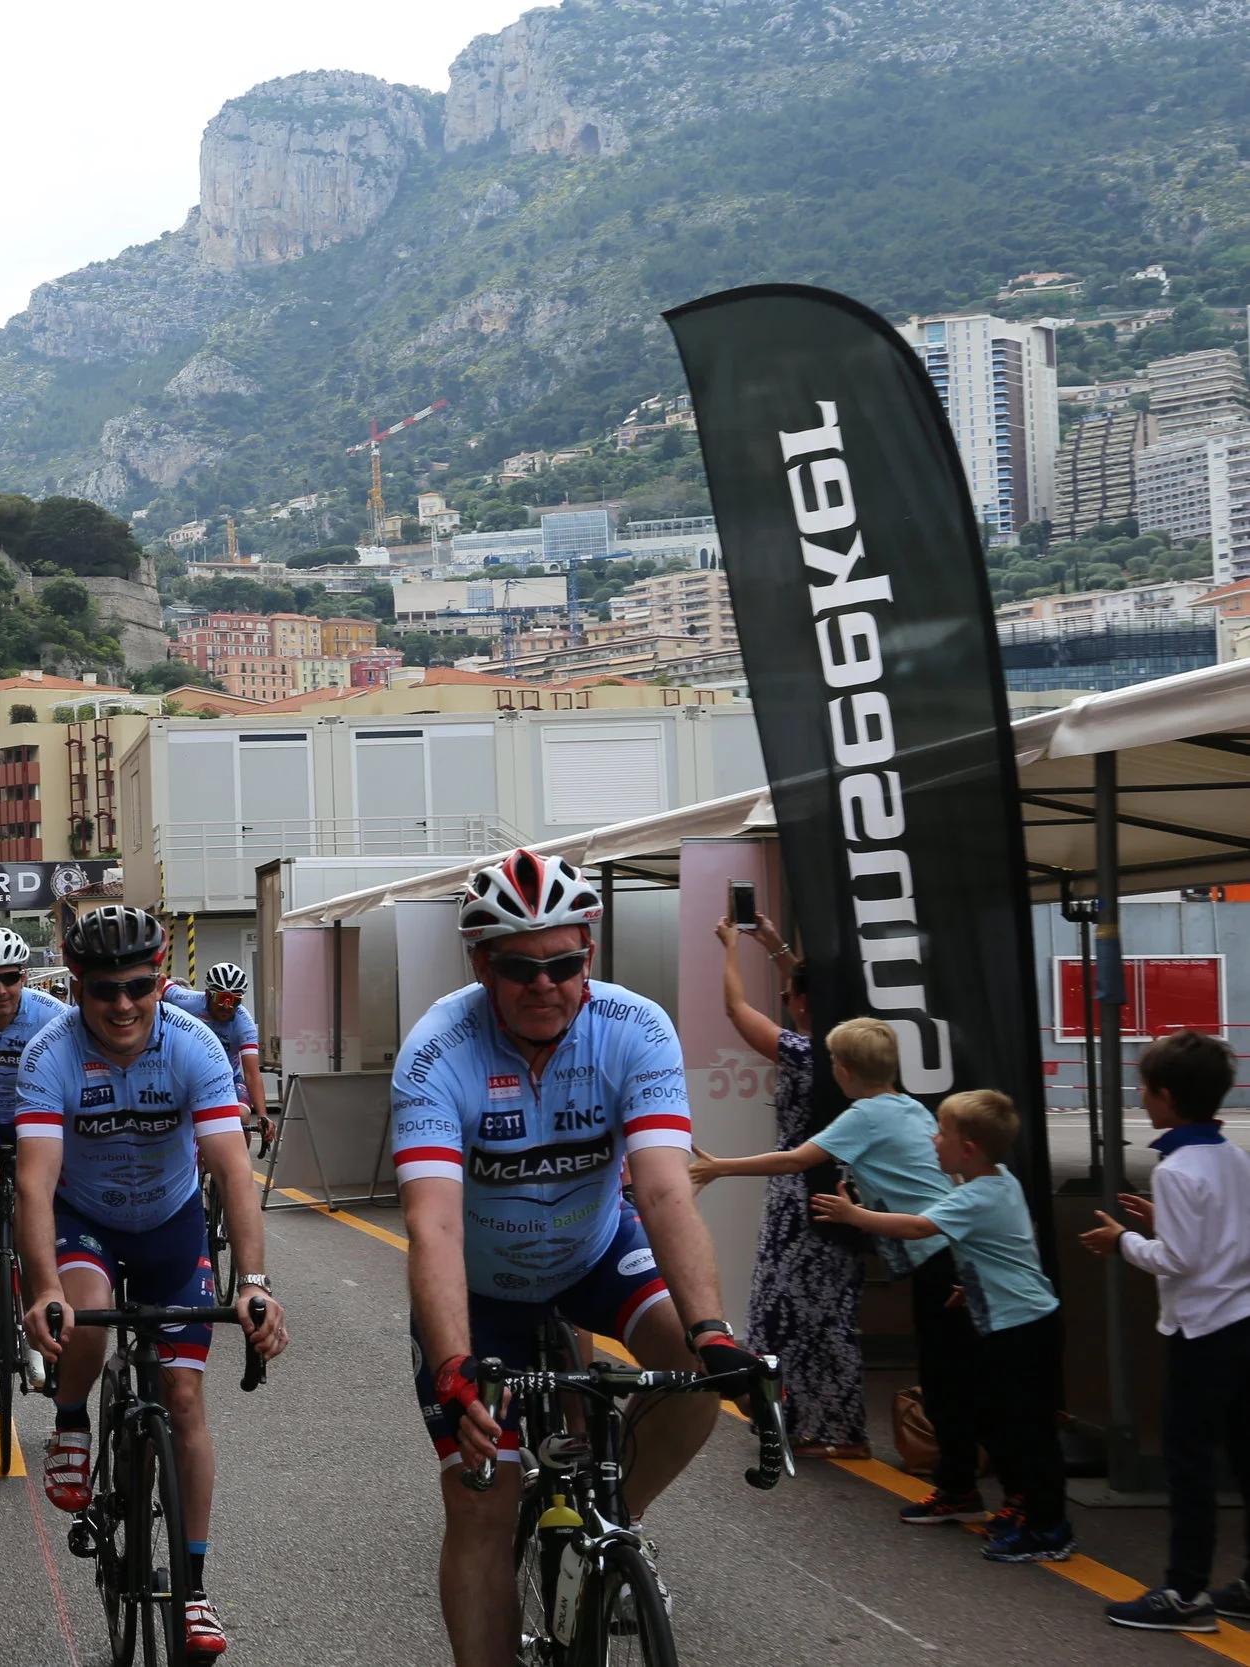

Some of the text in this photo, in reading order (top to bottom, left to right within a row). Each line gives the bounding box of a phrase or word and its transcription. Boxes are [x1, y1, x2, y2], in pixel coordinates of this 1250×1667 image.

[8, 1038, 26, 1048] ZIN
[138, 1090, 174, 1105] ZINC
[78, 1115, 179, 1135] McLAREN
[397, 1118, 460, 1135] BOUTSEN
[483, 1114, 521, 1130] COTT
[553, 1104, 606, 1132] ZINC
[473, 1146, 611, 1180] McLAREN
[468, 1200, 604, 1234] metabolic balan
